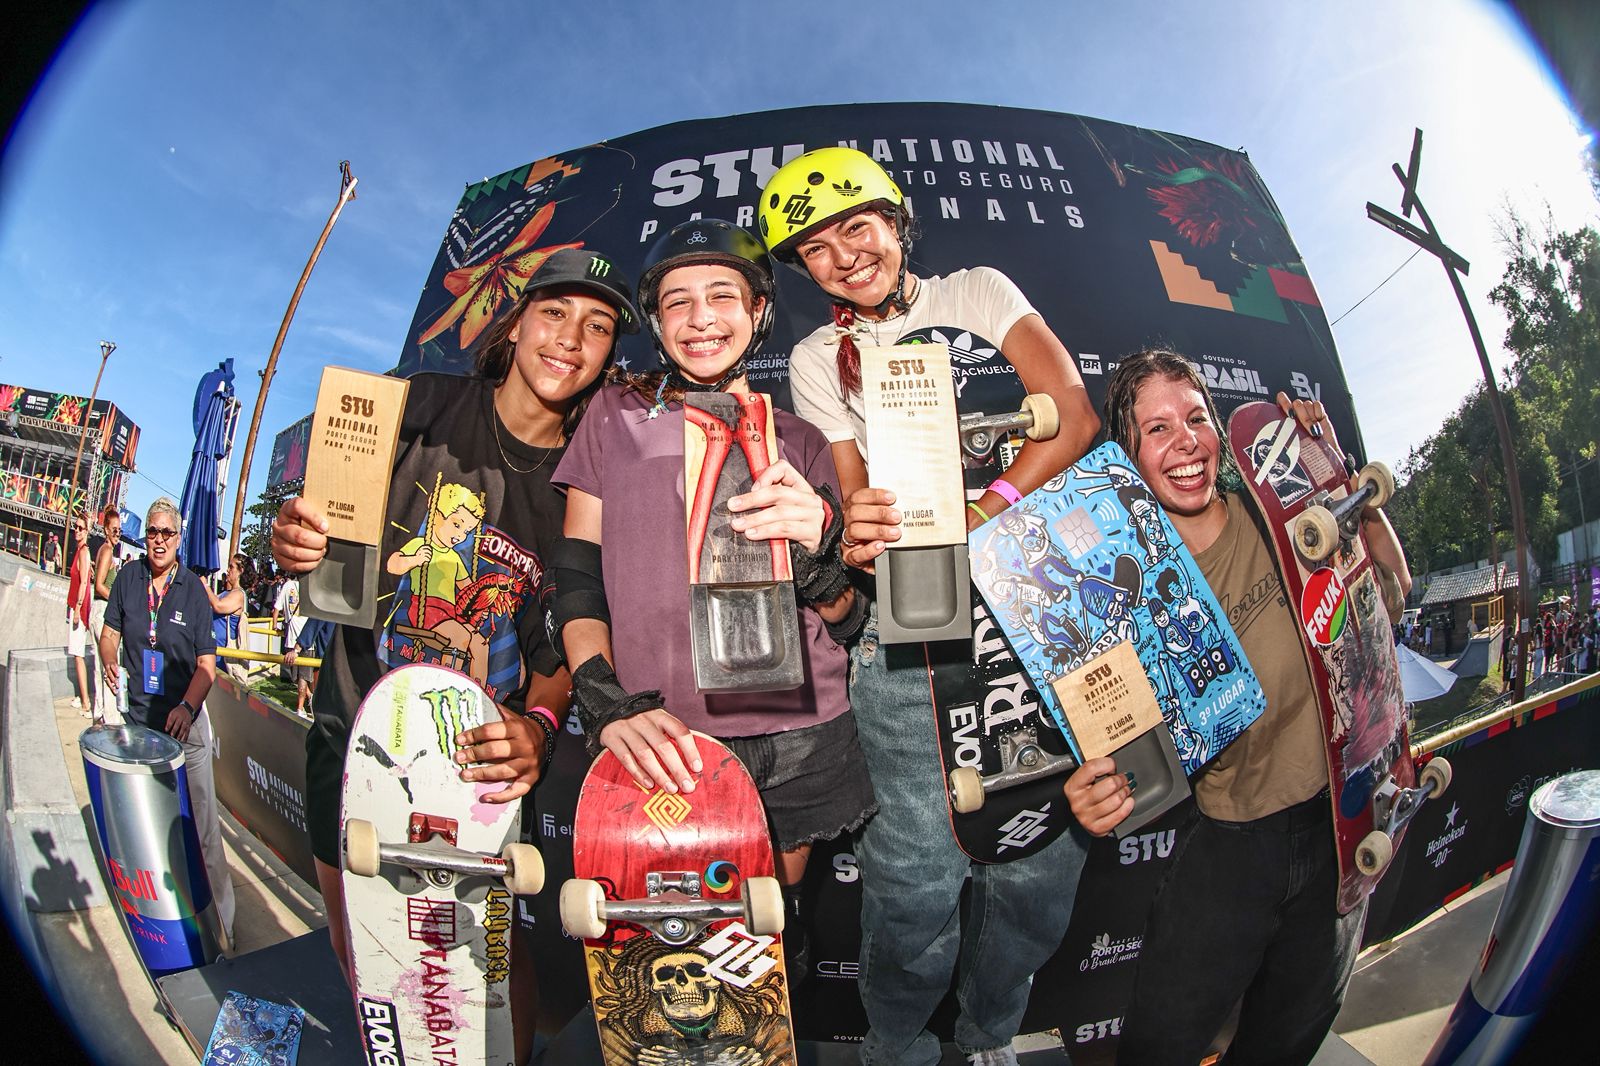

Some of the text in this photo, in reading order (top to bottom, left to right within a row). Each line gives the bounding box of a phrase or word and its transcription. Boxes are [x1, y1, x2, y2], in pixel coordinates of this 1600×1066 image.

[959, 171, 1073, 194] SEGURO
[888, 358, 925, 376] STU
[1203, 354, 1235, 364] GOVERNO
[880, 378, 936, 391] NATIONAL
[341, 394, 375, 418] STU
[328, 416, 378, 436] NATIONAL
[325, 439, 344, 449] PARK
[336, 501, 355, 513] LUGAR
[912, 509, 934, 519] LUGAR
[489, 536, 543, 586] OFFSPRING
[712, 554, 731, 563] PARK
[1306, 566, 1343, 647] FRUKI
[1084, 663, 1112, 687] STU
[1084, 674, 1123, 702] NATIONAL
[1212, 678, 1246, 716] LUGAR
[1113, 713, 1133, 730] LUGAR
[247, 756, 303, 807] STU NATIONAL
[1118, 828, 1176, 866] STU
[1425, 823, 1467, 857] Heineken
[109, 856, 158, 902] Bull
[1091, 944, 1125, 958] PORTO
[1091, 952, 1119, 969] Brasil
